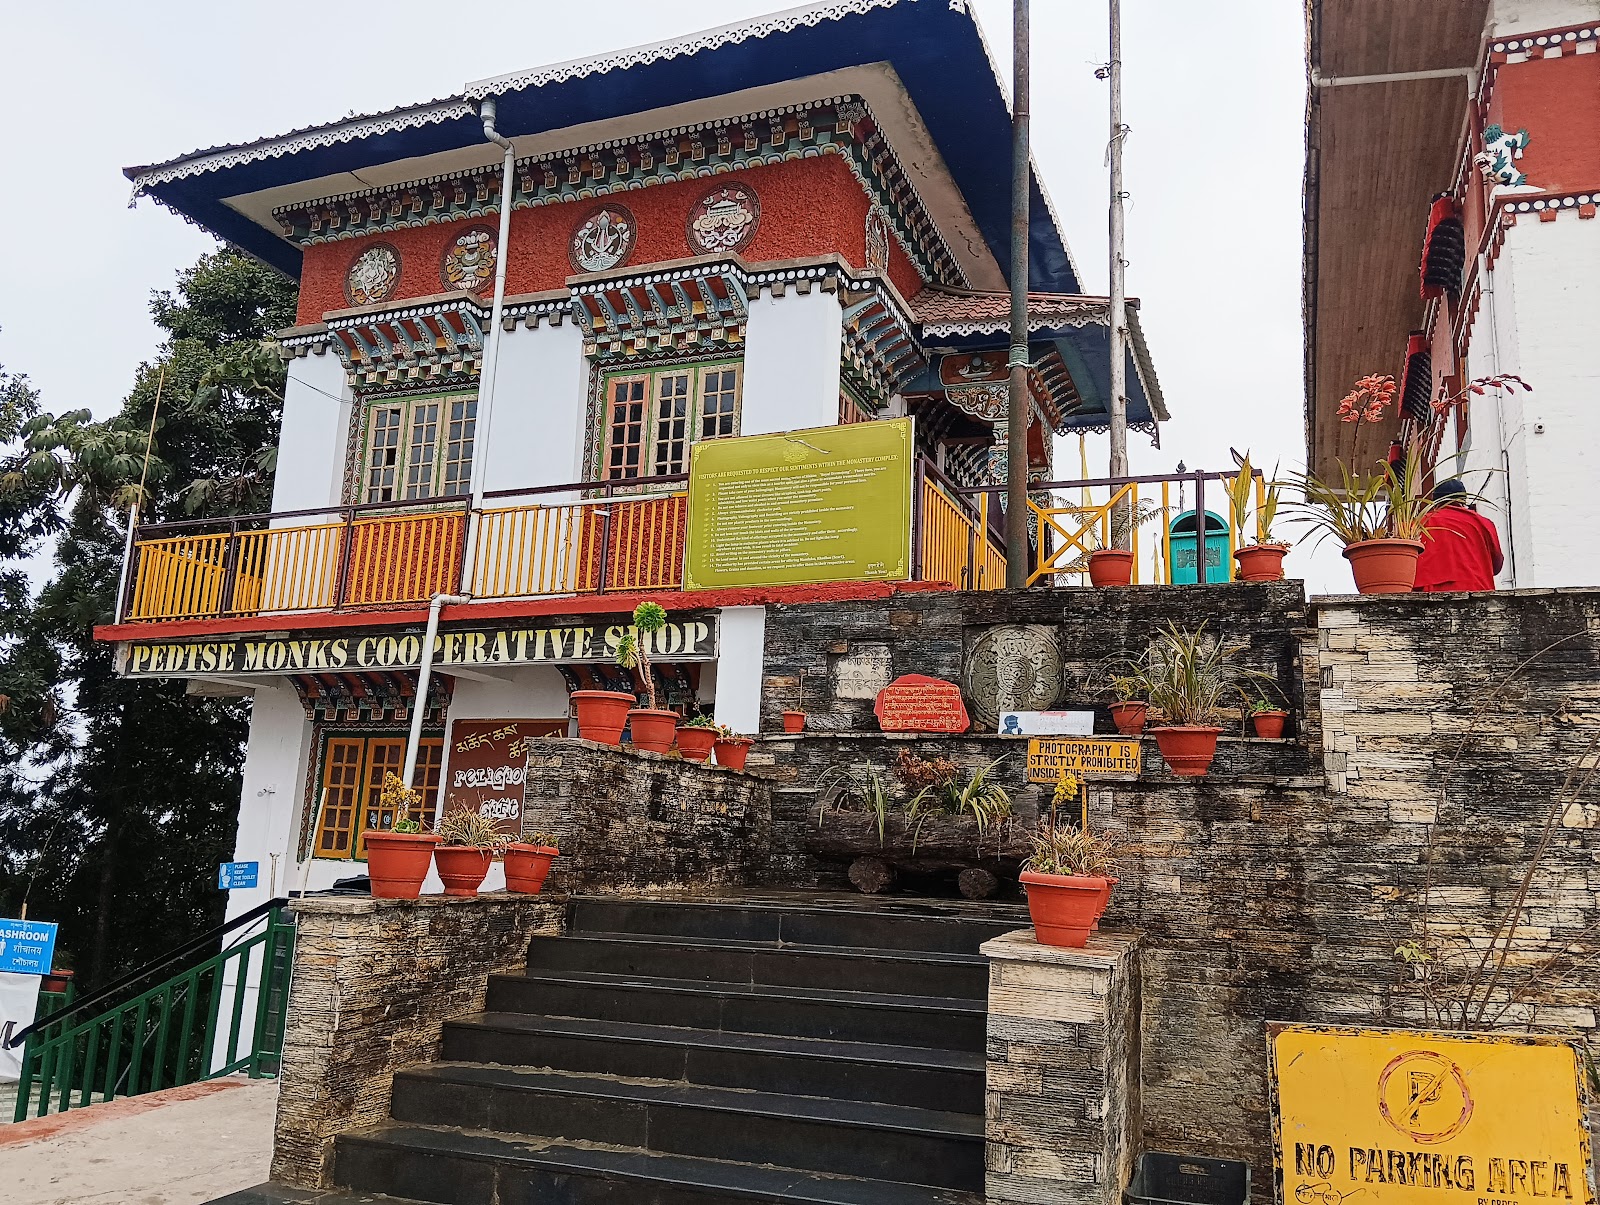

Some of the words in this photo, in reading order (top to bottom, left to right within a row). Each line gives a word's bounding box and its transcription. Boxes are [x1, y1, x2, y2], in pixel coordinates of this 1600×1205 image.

[790, 463, 818, 471] SENTIMENTS
[847, 457, 874, 465] MONASTERY
[131, 643, 236, 672] PEDTSE
[242, 638, 349, 671] MONKS
[357, 627, 594, 667] COOPERATIVE
[1039, 742, 1112, 756] PHOTOGRAPHY
[1120, 746, 1131, 758] IS
[1030, 755, 1076, 767] STRICTLY
[1081, 757, 1138, 768] PROHIBITED
[1030, 768, 1060, 778] INSIDE
[13, 942, 42, 955] शौचालय
[1295, 1142, 1336, 1180] NO
[1349, 1146, 1475, 1191] PARKING
[1487, 1156, 1573, 1199] AREA
